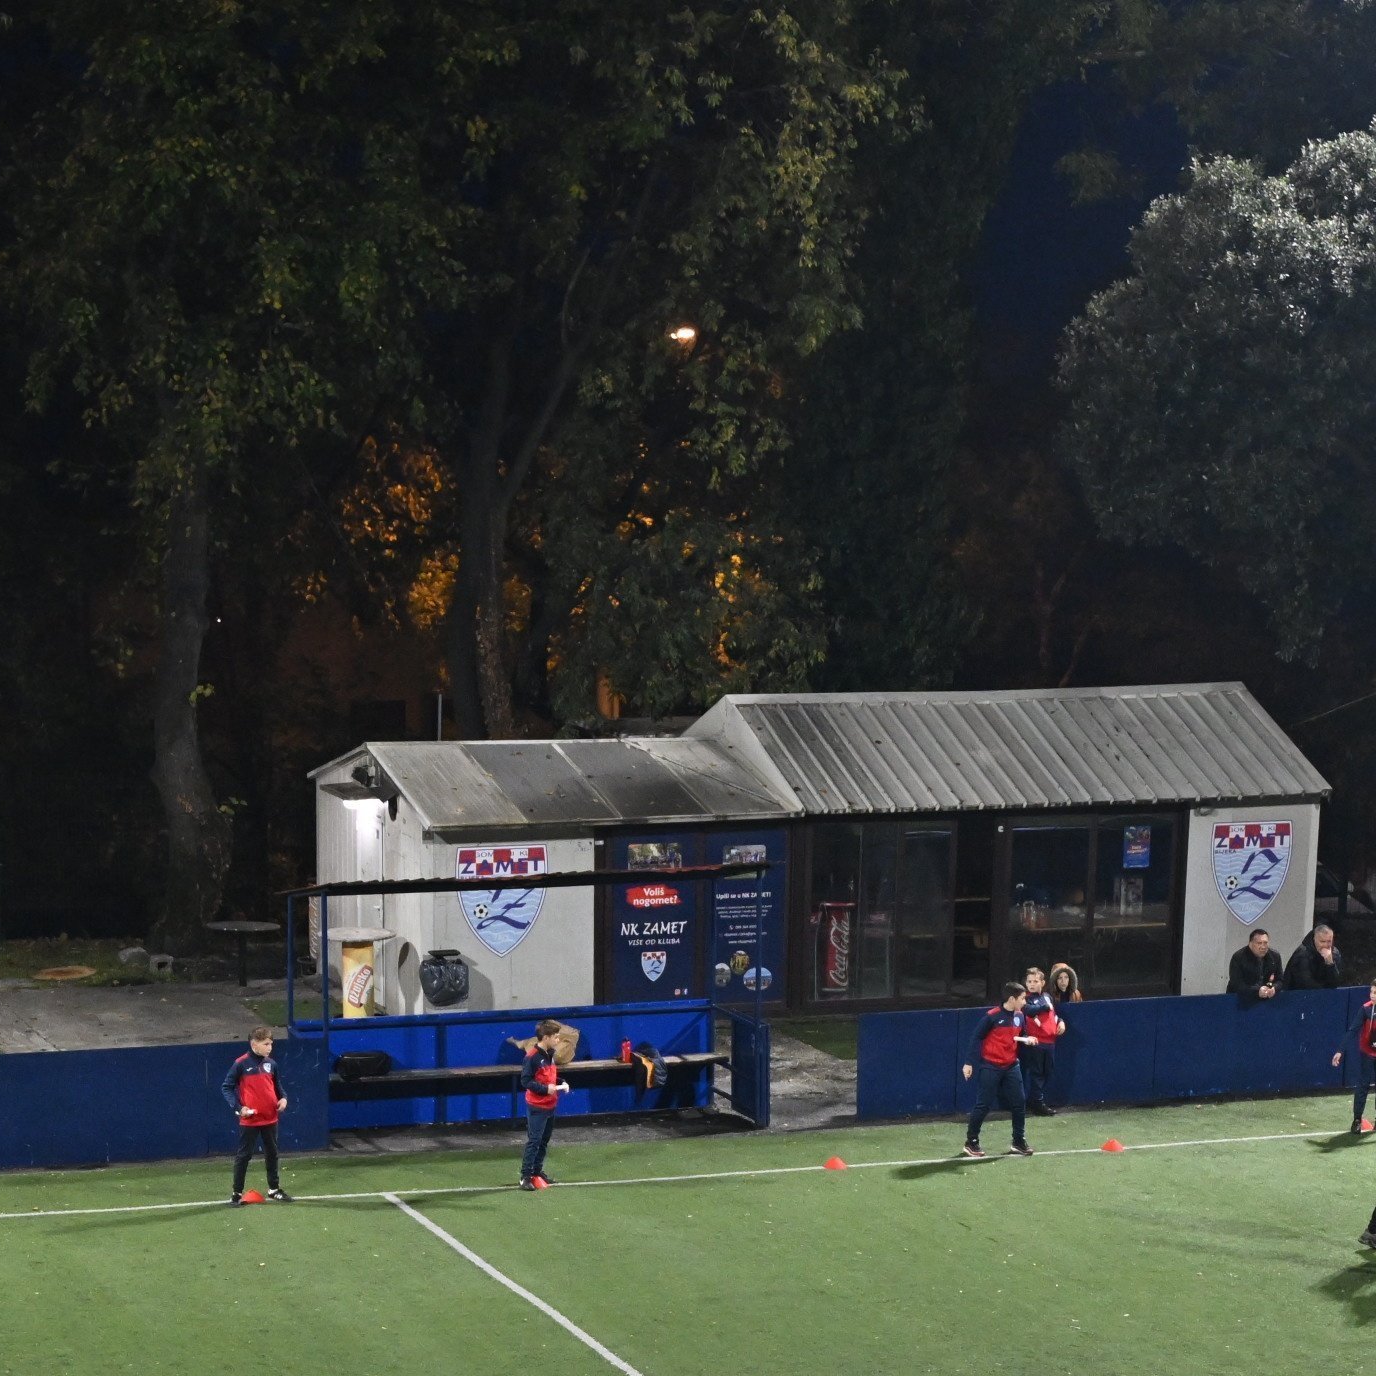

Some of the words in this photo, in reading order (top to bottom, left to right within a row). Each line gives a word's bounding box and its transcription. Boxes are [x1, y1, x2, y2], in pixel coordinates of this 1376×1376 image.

[1216, 832, 1287, 848] ZAMET
[461, 857, 540, 875] ZAMET
[643, 887, 665, 897] Voliš
[633, 896, 678, 907] nogomet?
[620, 922, 640, 937] NK
[643, 920, 688, 935] ZAMET
[628, 938, 644, 946] VIŠE
